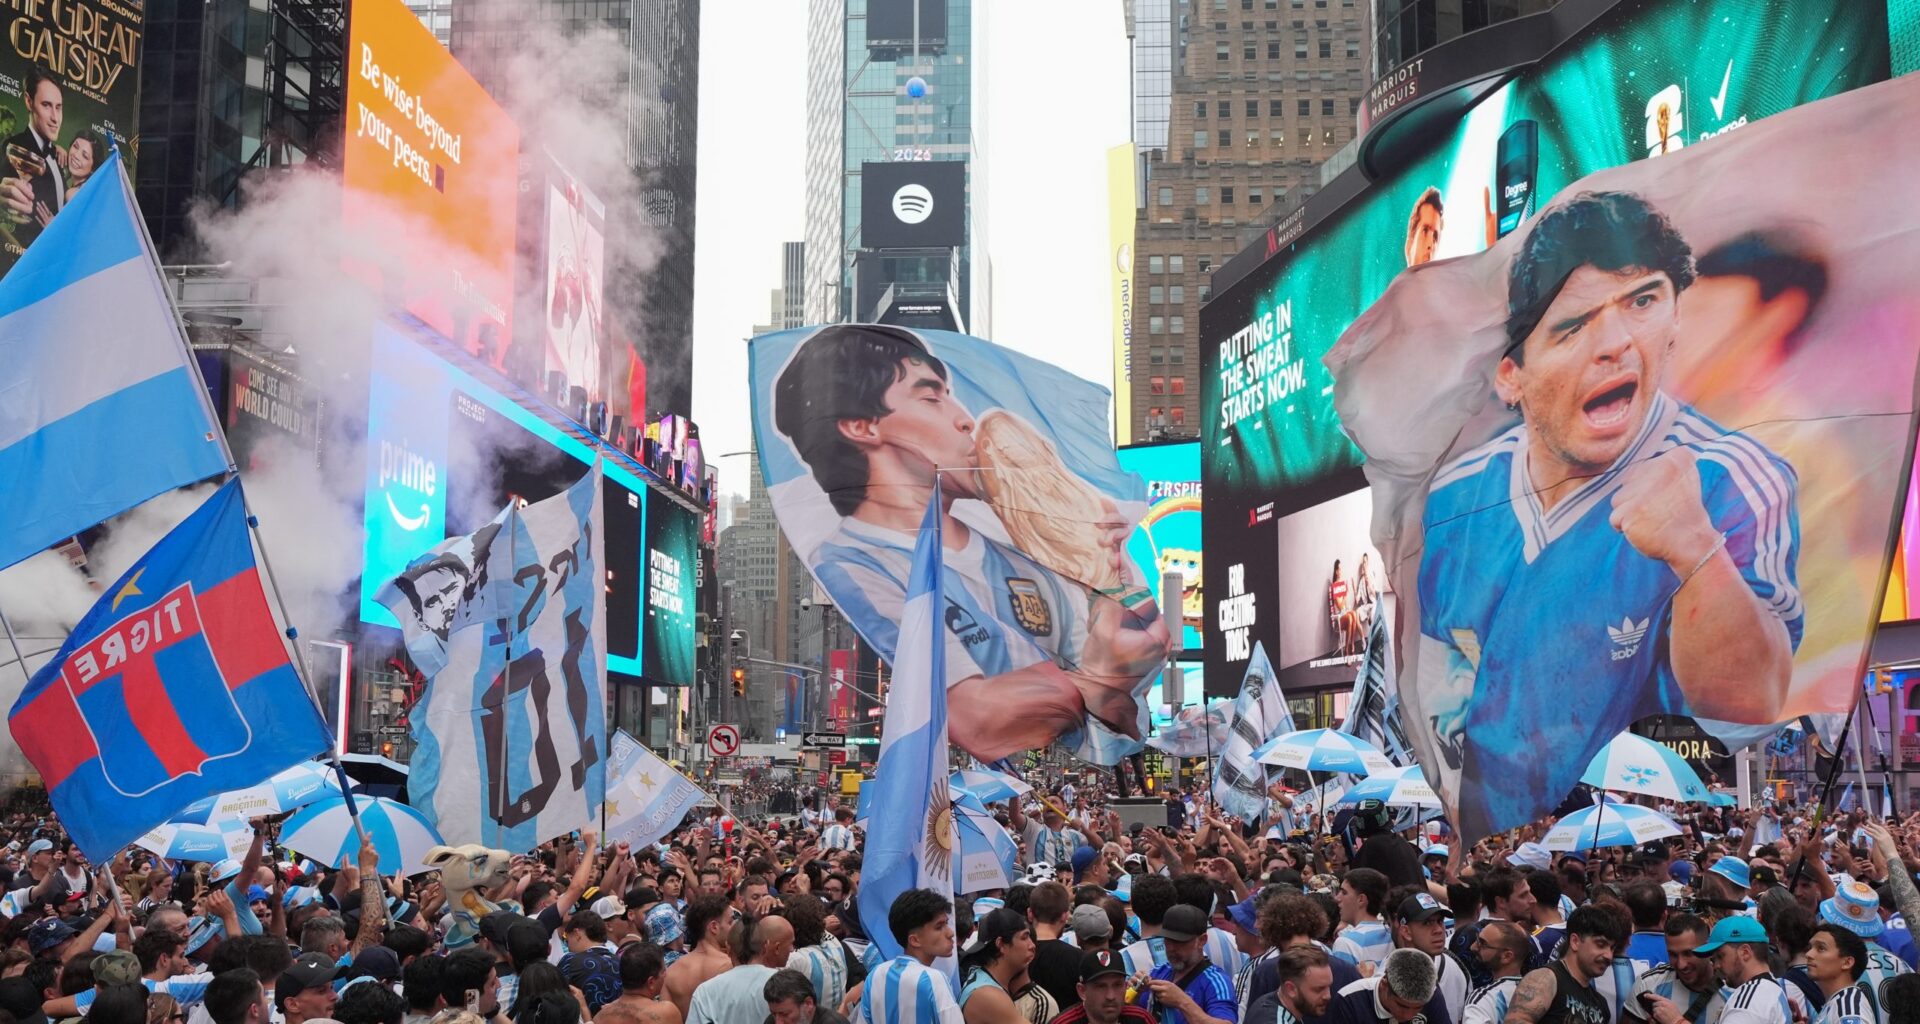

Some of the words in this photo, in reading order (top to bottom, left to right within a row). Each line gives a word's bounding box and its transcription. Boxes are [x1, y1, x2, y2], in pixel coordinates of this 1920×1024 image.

[101, 0, 142, 24] BROADWAY
[52, 0, 141, 67] GREAT
[10, 17, 122, 95] GATSBY
[0, 84, 23, 98] ARNEY
[67, 82, 82, 93] NEW
[82, 88, 108, 105] MUSICAL
[1371, 58, 1424, 103] MARRIOTT
[360, 42, 381, 89] Be
[383, 75, 414, 120] wise
[416, 95, 461, 165] beyond
[1371, 81, 1416, 121] MARQUIS
[91, 123, 127, 145] NOBLZADA
[103, 119, 116, 131] EVA
[357, 102, 392, 151] your
[393, 134, 433, 187] peers.
[894, 149, 932, 161] 2026
[1504, 181, 1528, 198] Degree
[1278, 205, 1305, 233] MARRIOTT
[1219, 311, 1274, 370] PUTTING
[1276, 298, 1292, 335] IN
[1220, 361, 1244, 399] THE
[1246, 331, 1292, 385] SWEAT
[248, 367, 266, 392] COME
[266, 375, 279, 398] SEE
[1221, 381, 1264, 430] STARTS
[1267, 357, 1307, 406] NOW.
[235, 383, 269, 420] WORLD
[270, 401, 300, 435] COULD
[458, 395, 486, 417] PROJECT
[379, 437, 436, 497] prime
[650, 548, 674, 574] PUTTING
[650, 567, 662, 588] THE
[1228, 563, 1245, 598] FOR
[649, 586, 669, 609] STARTS
[1218, 592, 1256, 632] CREATING
[1224, 626, 1250, 662] TOOLS
[221, 799, 268, 814] ARGENTINA
[1864, 952, 1899, 974] SSI
